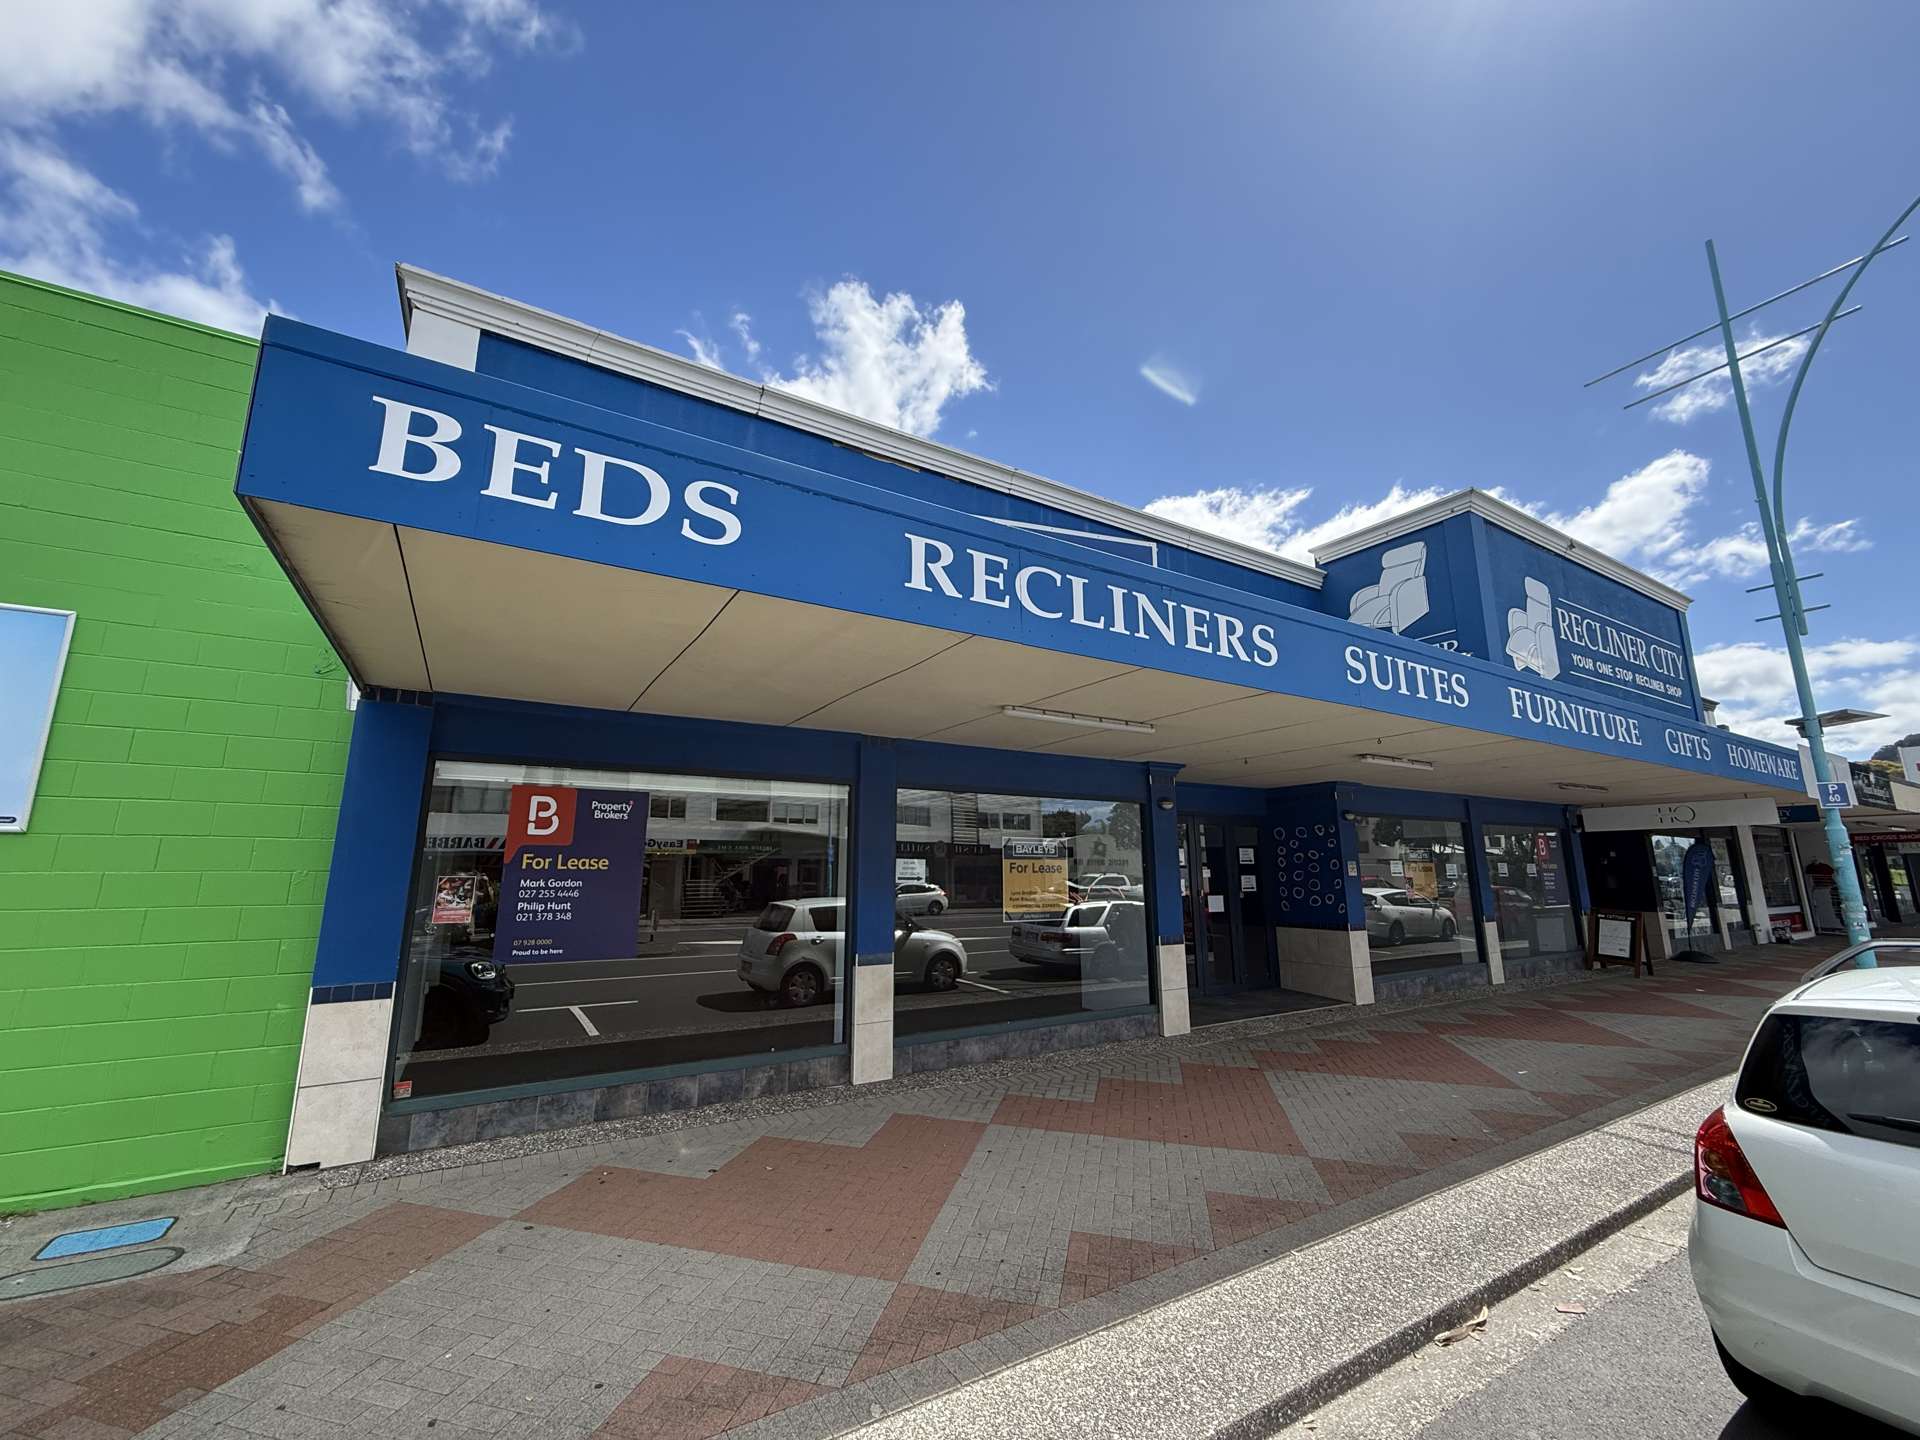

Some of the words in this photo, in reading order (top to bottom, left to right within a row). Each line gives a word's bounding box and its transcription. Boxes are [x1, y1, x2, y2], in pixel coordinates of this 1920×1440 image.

[367, 395, 742, 546] BEDS
[904, 532, 1278, 668] RECLINERS
[1344, 645, 1469, 708] SUITES
[1508, 686, 1642, 746] FURNITURE
[1665, 728, 1712, 761] GIFTS
[1726, 743, 1799, 780] HOMEWARE
[1556, 607, 1650, 668] RECLINER
[1650, 644, 1685, 680] CITY
[1571, 653, 1595, 671] YOUR
[1596, 661, 1614, 676] ONE
[1615, 667, 1633, 682] STOP
[1635, 673, 1664, 693] RECLINER
[1666, 684, 1682, 697] SHOP
[1828, 784, 1838, 794] P
[1828, 794, 1841, 802] 60
[592, 800, 633, 812] Property
[527, 795, 559, 836] B
[594, 810, 629, 820] Brokers
[1657, 805, 1696, 824] HQ
[1015, 842, 1055, 854] BAYLEYS
[522, 853, 552, 870] For
[557, 854, 609, 870] Lease
[1009, 862, 1028, 874] For
[1031, 862, 1062, 874] Lease
[520, 879, 546, 888] Mark
[547, 879, 583, 888] Gordon
[518, 889, 536, 898] 027
[538, 889, 555, 898] 255
[557, 889, 580, 898] 4446
[517, 901, 545, 912] Philip
[547, 901, 571, 910] Hunt
[516, 913, 533, 922] 021
[536, 912, 553, 921] 378
[555, 912, 572, 920] 348
